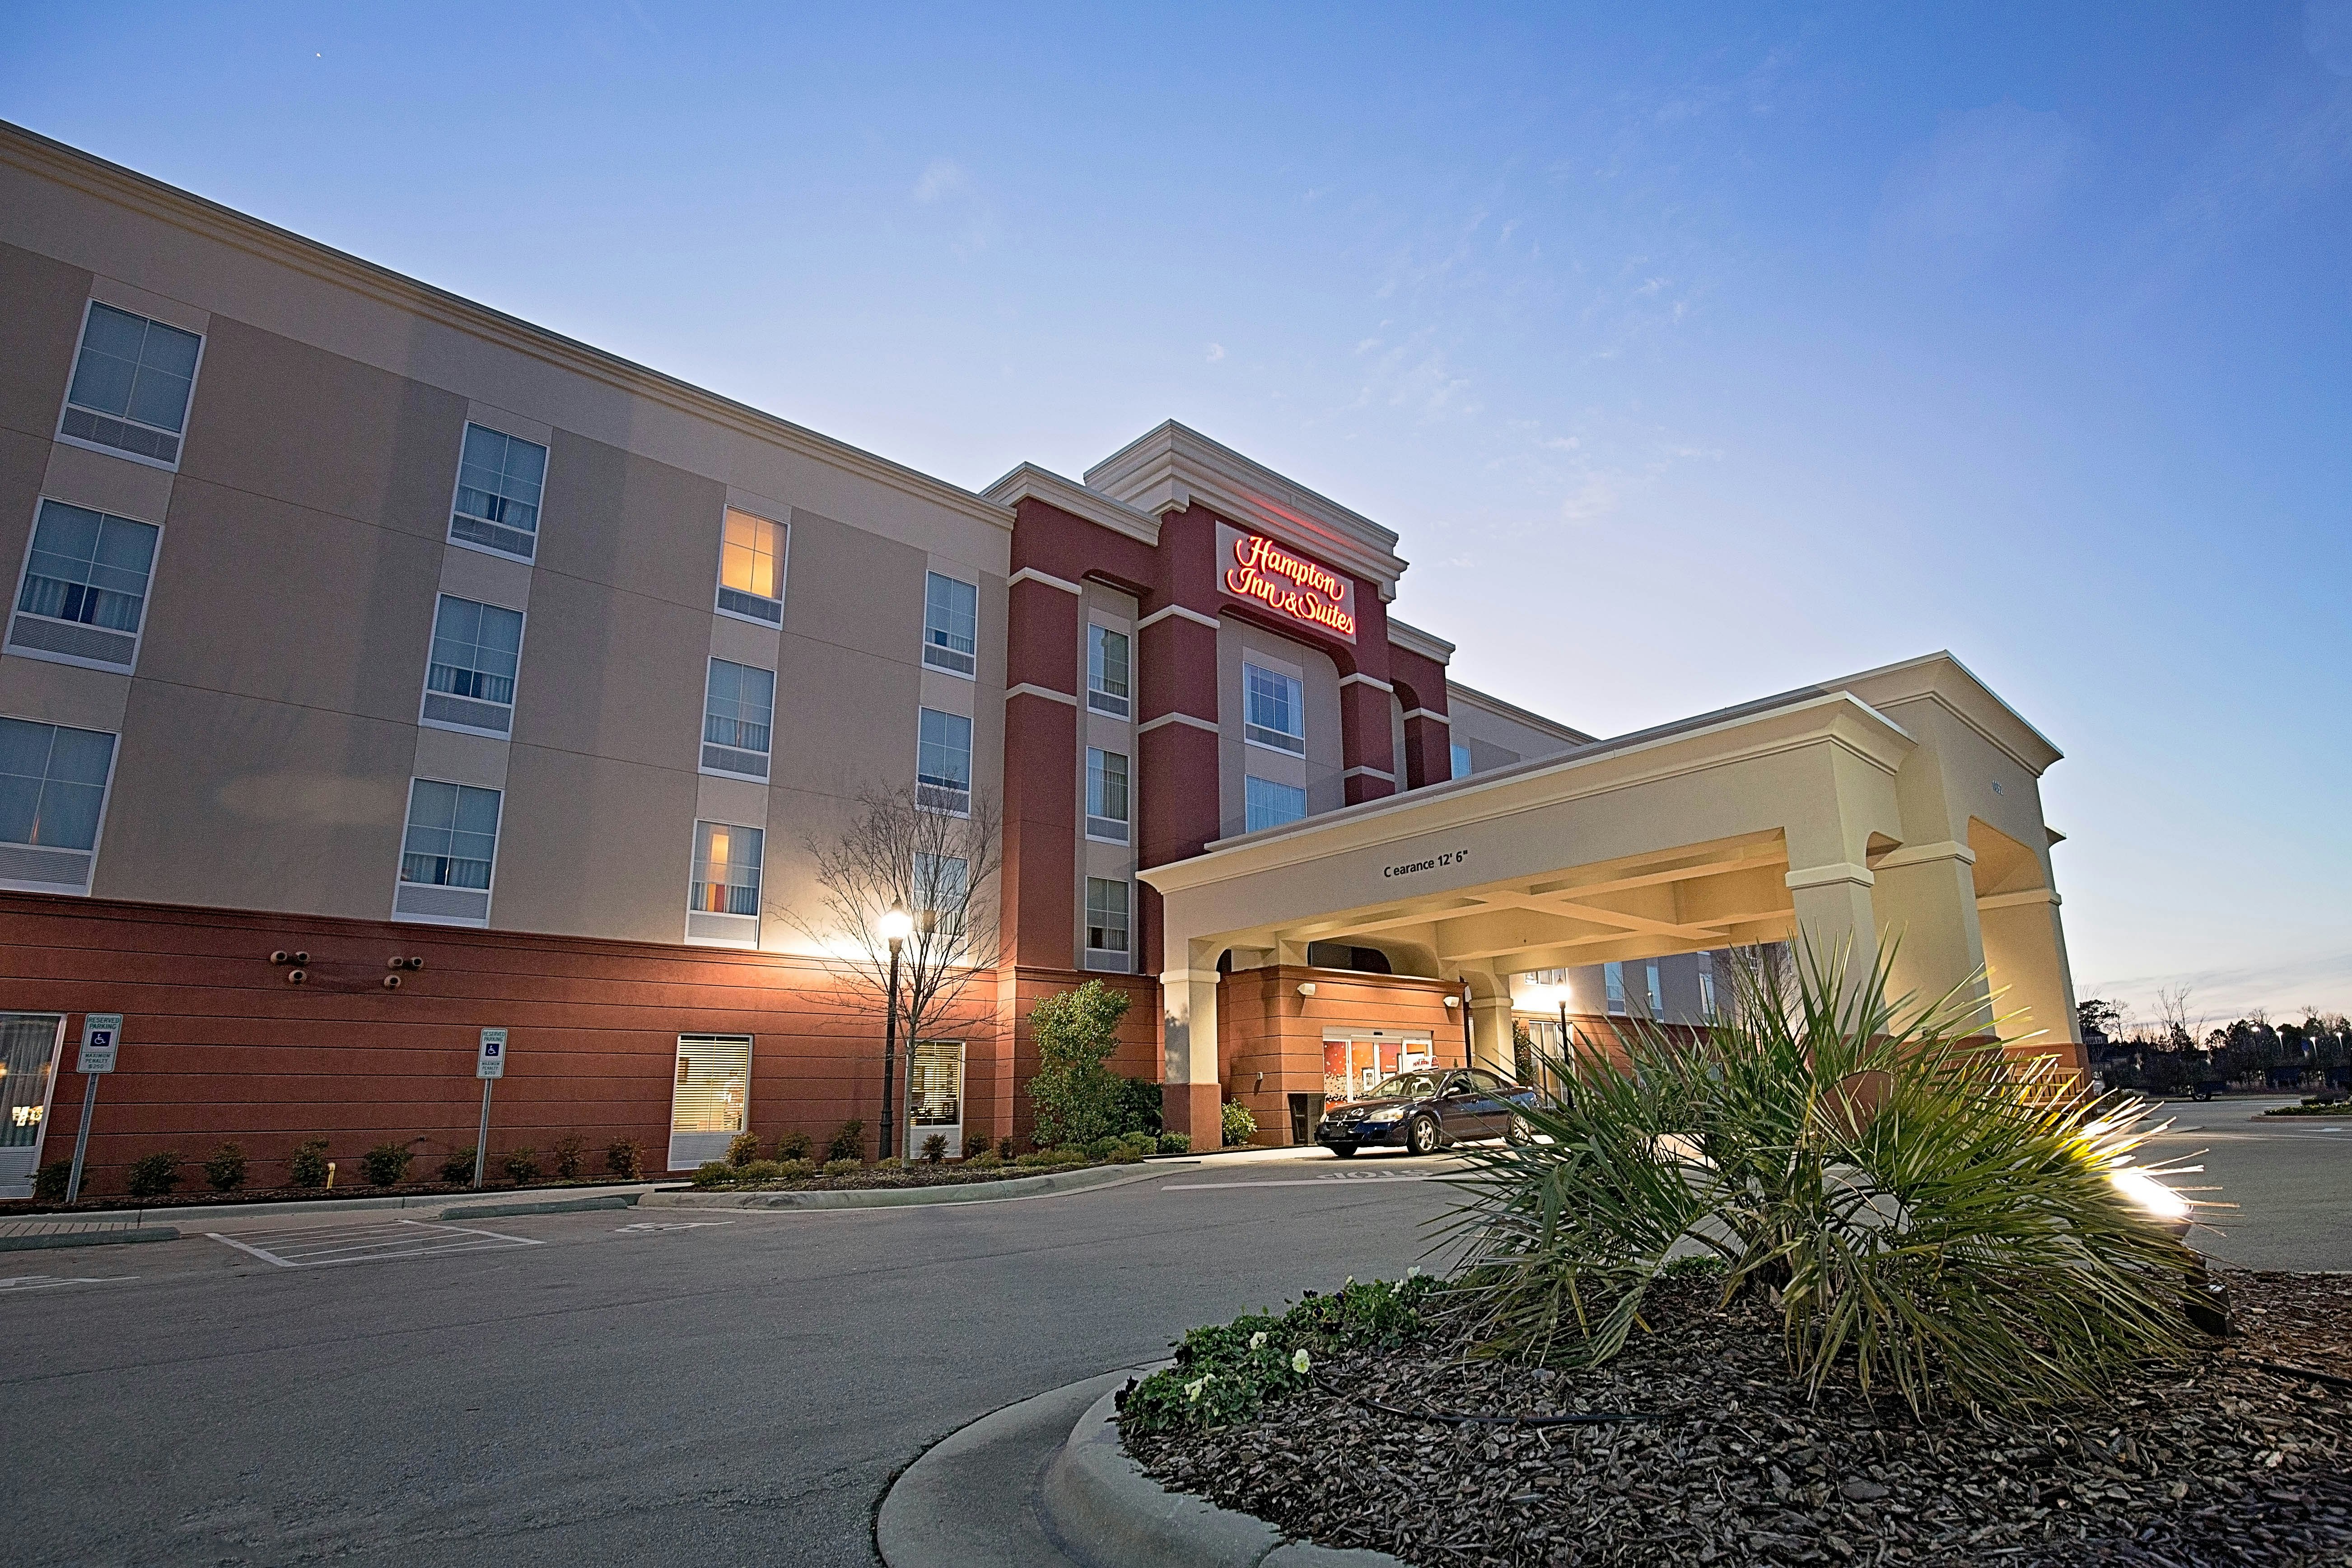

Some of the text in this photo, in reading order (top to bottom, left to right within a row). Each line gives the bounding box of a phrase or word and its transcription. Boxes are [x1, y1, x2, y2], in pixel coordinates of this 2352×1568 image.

[1234, 536, 1344, 601] Hampton
[1225, 568, 1354, 635] Inn & Suites
[1438, 853, 1452, 866] 12'
[1456, 850, 1468, 863] 6"
[1316, 1170, 1433, 1180] STOP
